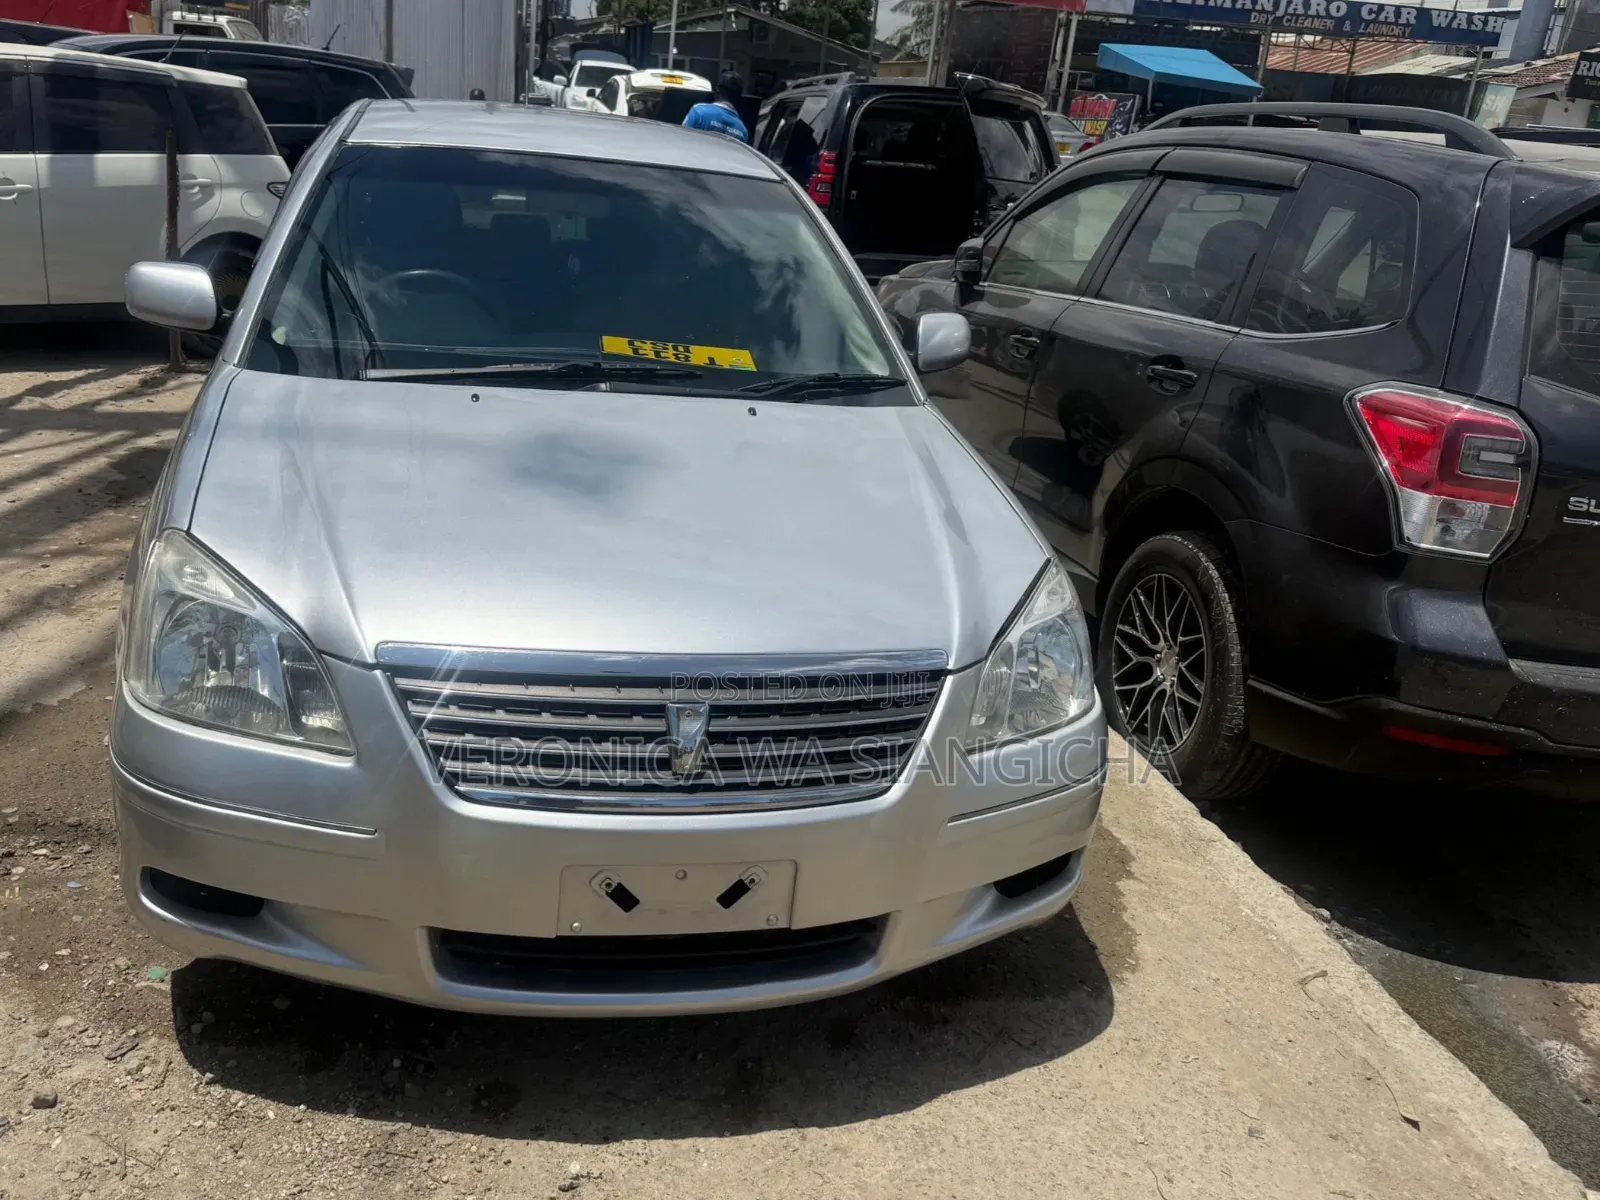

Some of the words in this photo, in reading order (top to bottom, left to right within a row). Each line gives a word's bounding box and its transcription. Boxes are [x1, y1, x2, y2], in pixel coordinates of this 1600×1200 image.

[1250, 12, 1276, 25] DRY
[1283, 15, 1335, 30] CLEANER
[1343, 21, 1351, 31] &
[1358, 22, 1413, 38] LAUNDRY
[1361, 4, 1417, 24] CAR
[1431, 10, 1505, 33] WASH
[703, 357, 724, 367] T
